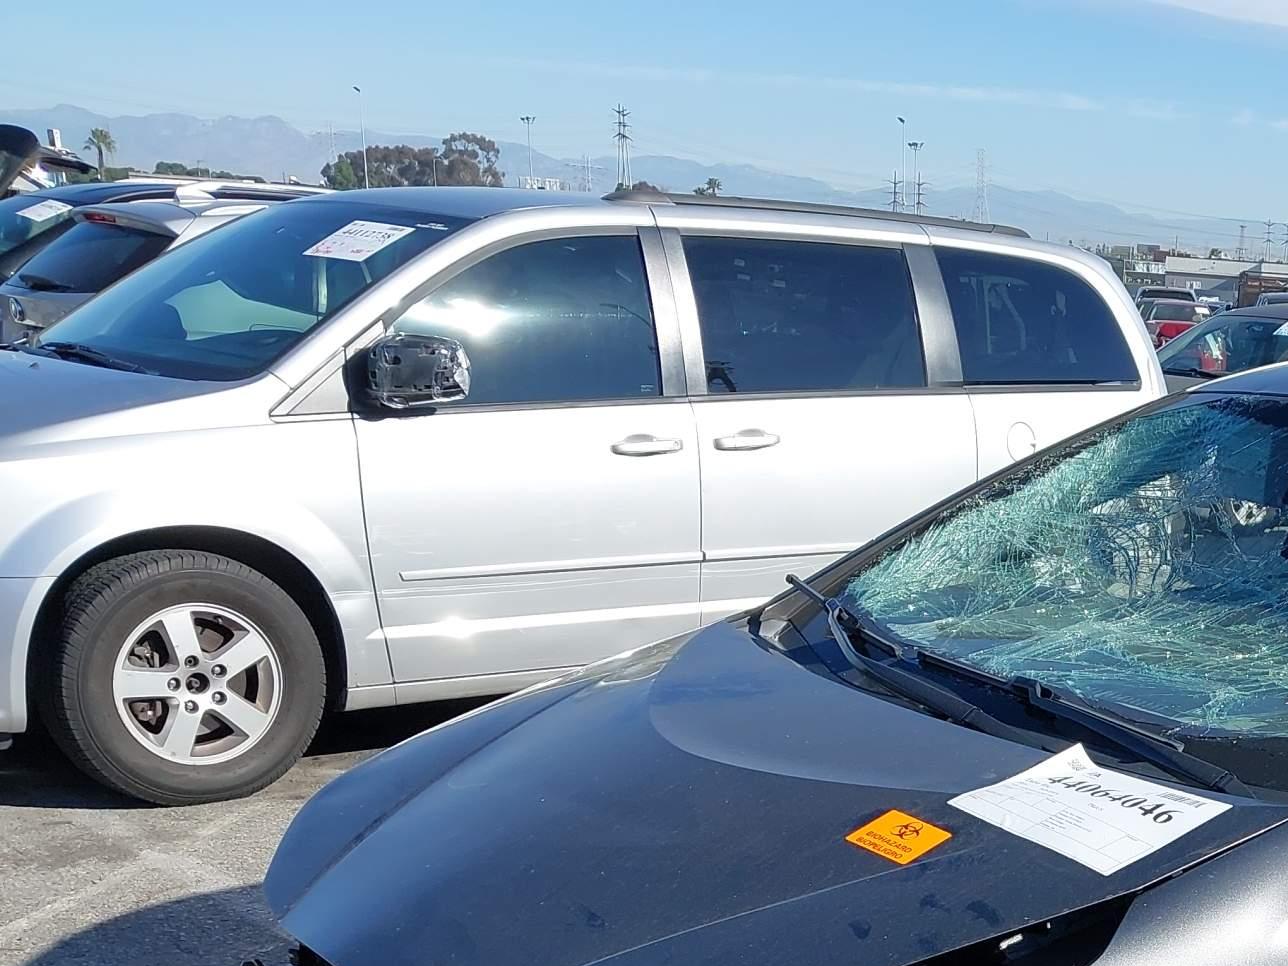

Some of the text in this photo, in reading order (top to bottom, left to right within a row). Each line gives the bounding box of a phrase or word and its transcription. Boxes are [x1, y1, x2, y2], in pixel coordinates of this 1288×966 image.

[1047, 776, 1184, 824] 44064046
[856, 836, 903, 859] BIOPELIGRO
[865, 831, 913, 853] BIOHAZARD
